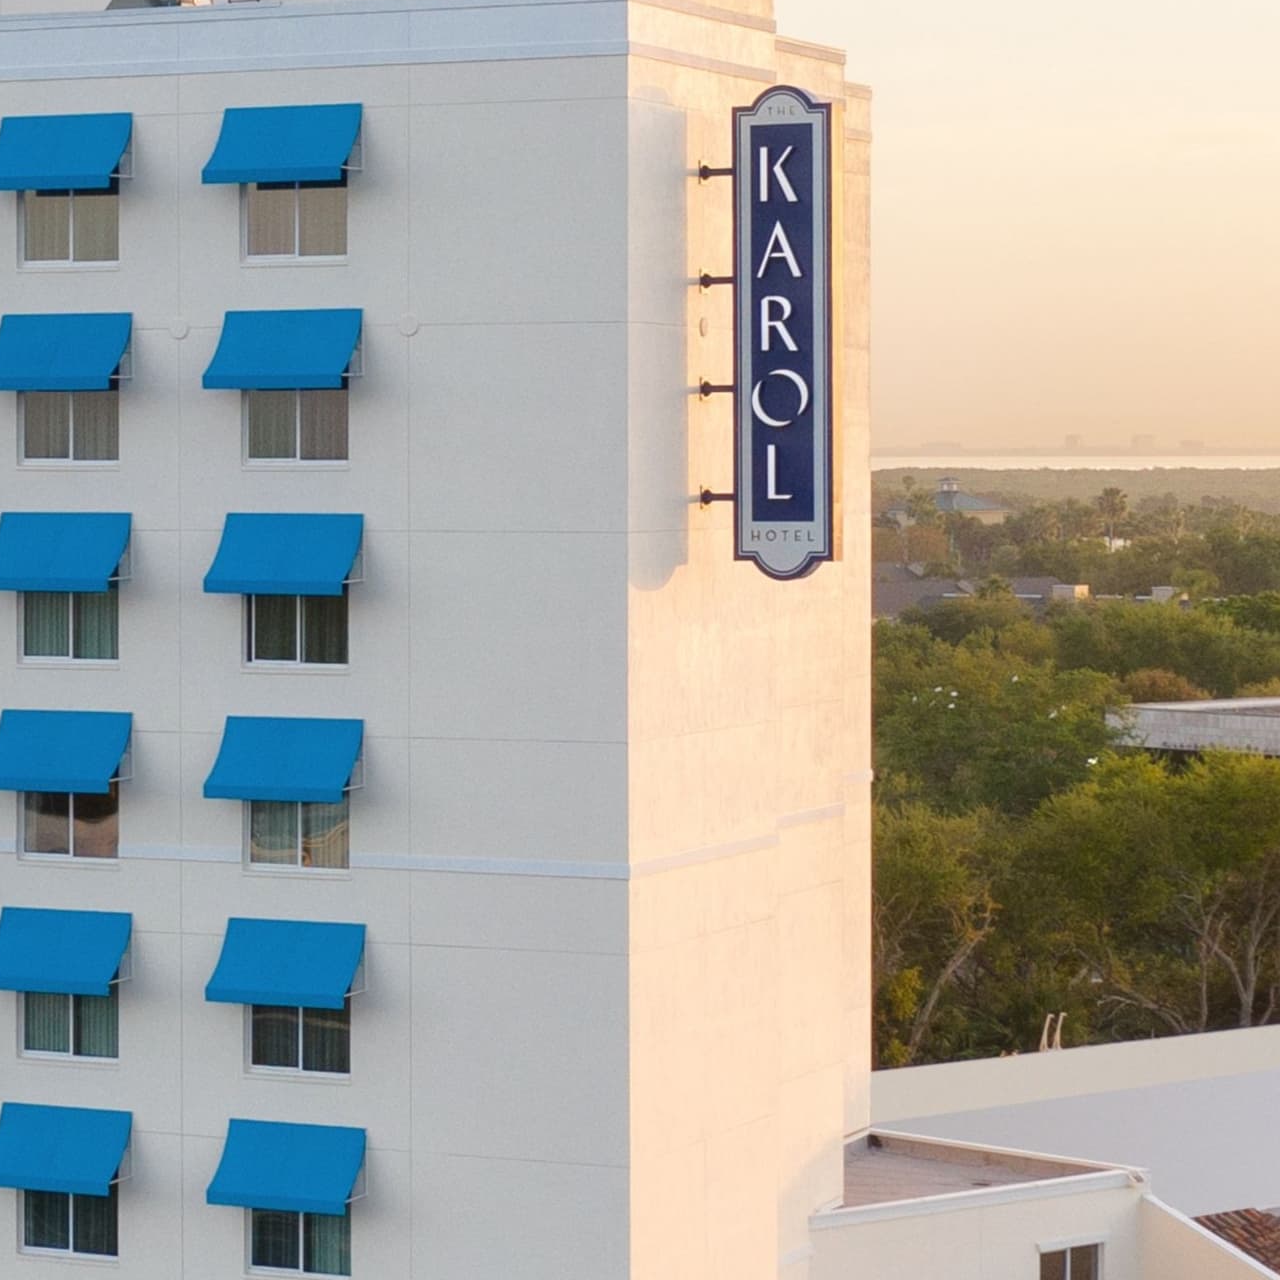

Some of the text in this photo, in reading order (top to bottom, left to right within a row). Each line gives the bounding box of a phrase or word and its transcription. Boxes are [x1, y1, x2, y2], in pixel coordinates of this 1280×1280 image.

[767, 105, 796, 117] THE
[751, 145, 810, 500] KAROL
[750, 529, 816, 543] HOTEL
